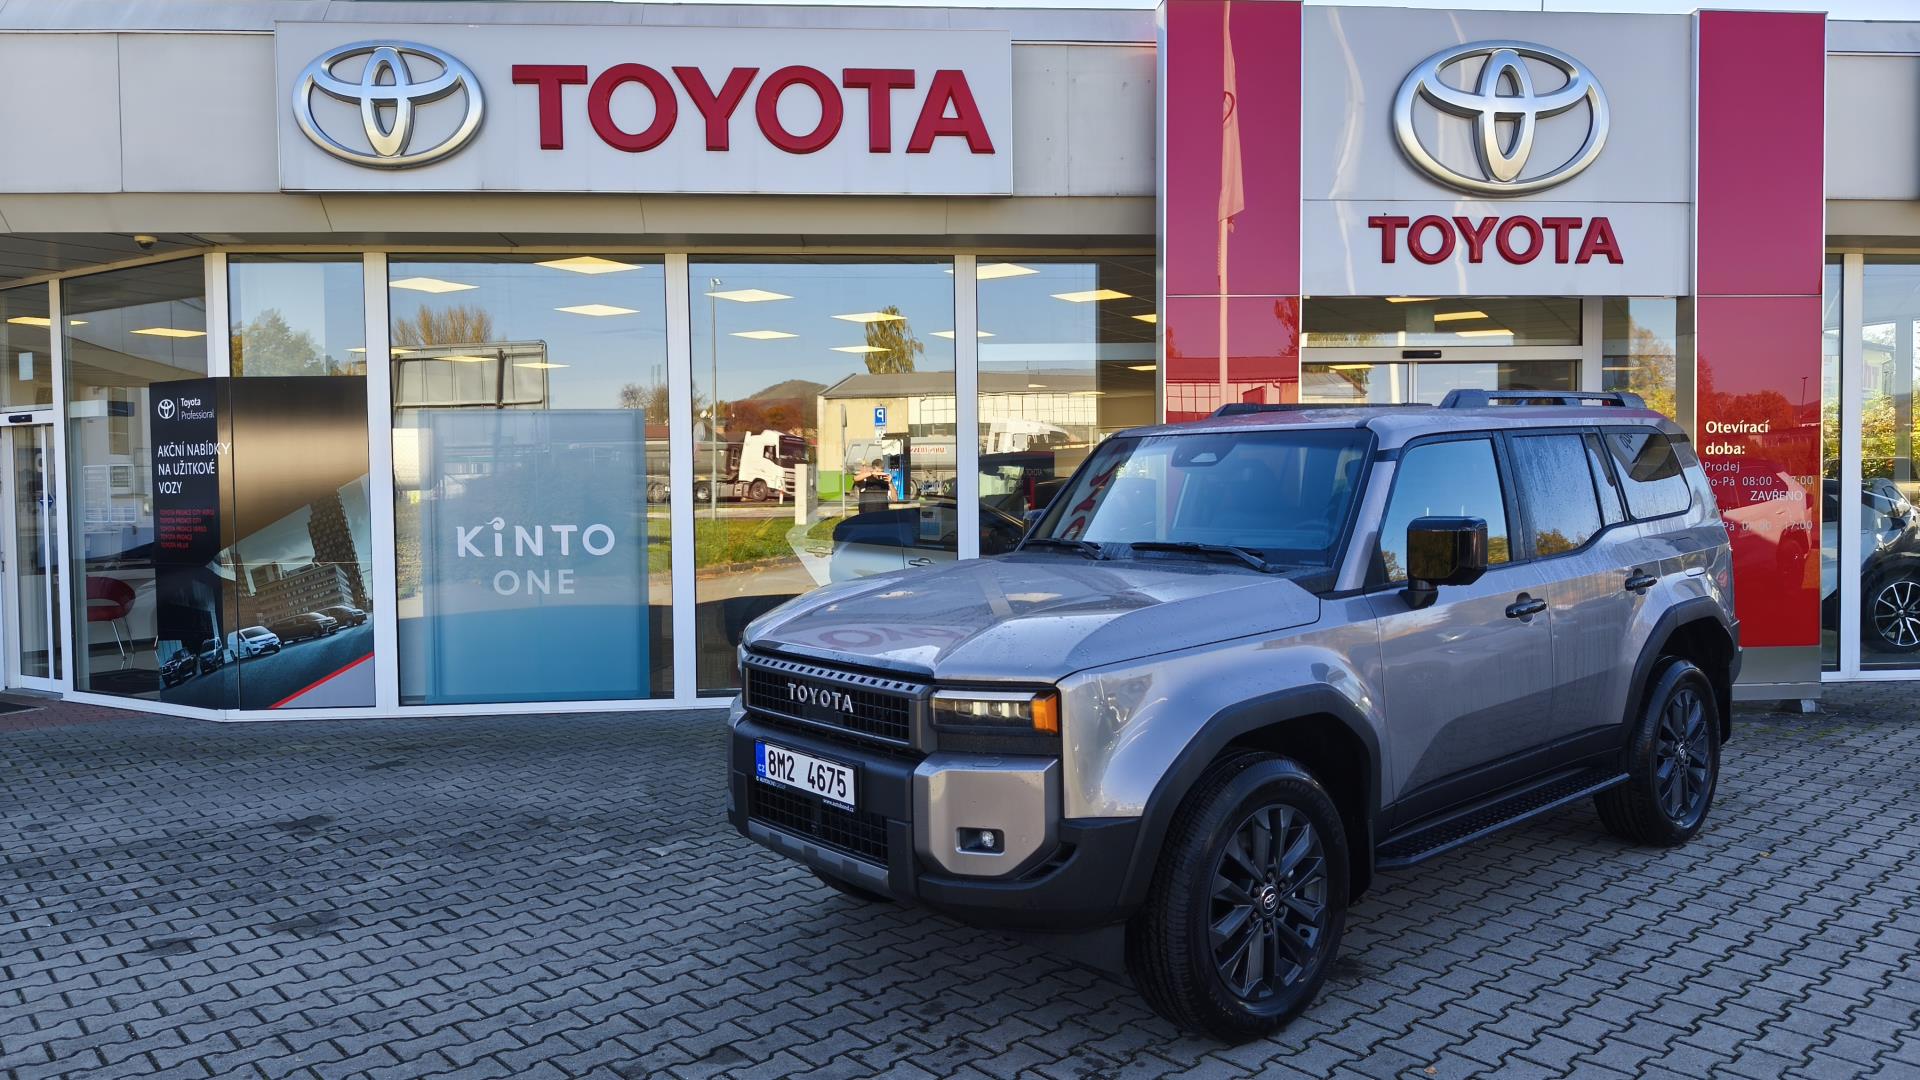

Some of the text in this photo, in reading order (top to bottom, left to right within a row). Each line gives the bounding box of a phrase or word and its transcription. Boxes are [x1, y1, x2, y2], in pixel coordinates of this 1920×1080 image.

[512, 62, 996, 155] TOYOTA
[1368, 214, 1624, 265] TOYOTA
[180, 397, 201, 408] Toyota
[181, 408, 215, 420] Professional
[1705, 419, 1770, 434] Otevírací
[157, 440, 231, 457] AKČNÍ NABÍDKY
[1705, 441, 1746, 455] doba:
[158, 459, 215, 476] NA UŽITKOVÉ
[1704, 461, 1740, 473] Prodej
[158, 481, 182, 494] VOZY
[1742, 476, 1772, 486] 08:00
[1750, 488, 1803, 501] ZAVŘENO
[493, 569, 575, 596] ONE
[787, 682, 854, 713] TOYOTA
[757, 764, 766, 773] CZ
[768, 749, 847, 798] 8M2 4675
